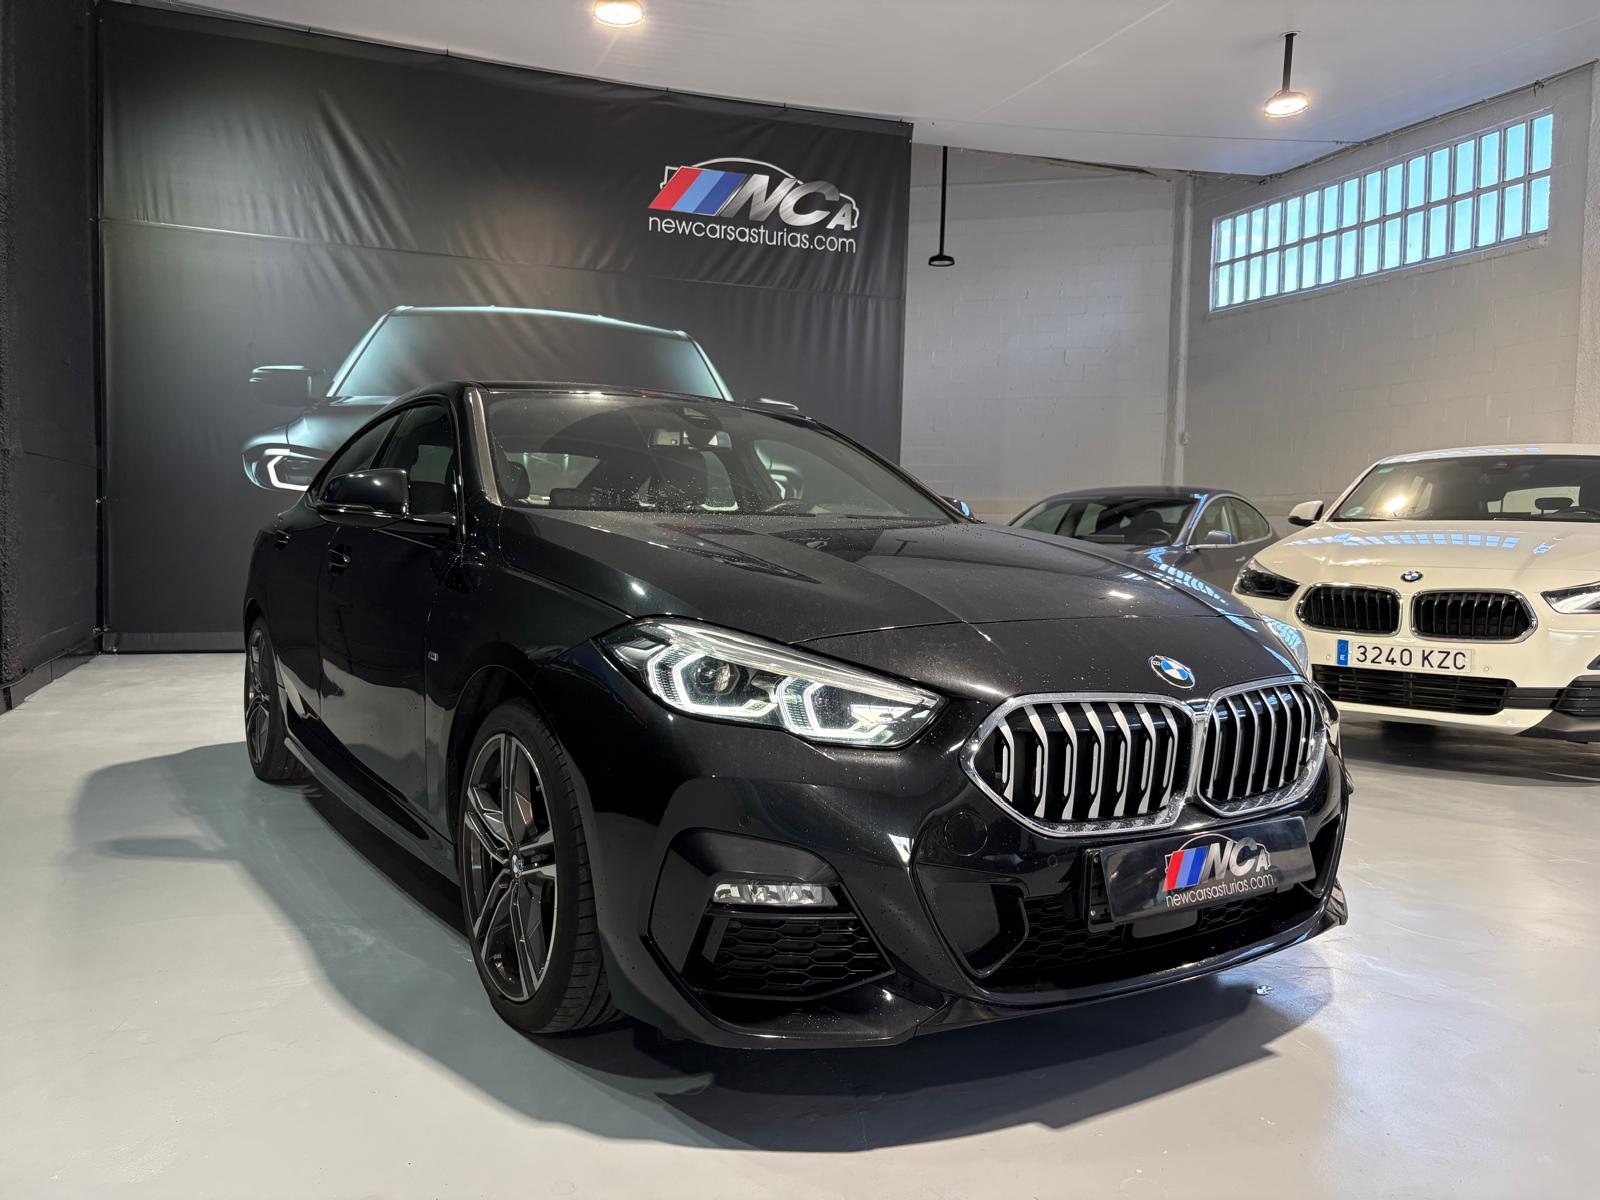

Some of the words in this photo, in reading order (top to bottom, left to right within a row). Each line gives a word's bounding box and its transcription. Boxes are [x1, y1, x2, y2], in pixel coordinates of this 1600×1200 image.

[648, 216, 856, 254] newcarsasturias.com
[1356, 645, 1413, 667] 3240
[1421, 649, 1466, 670] KZC
[1165, 872, 1274, 908] newcarsasturias.com
